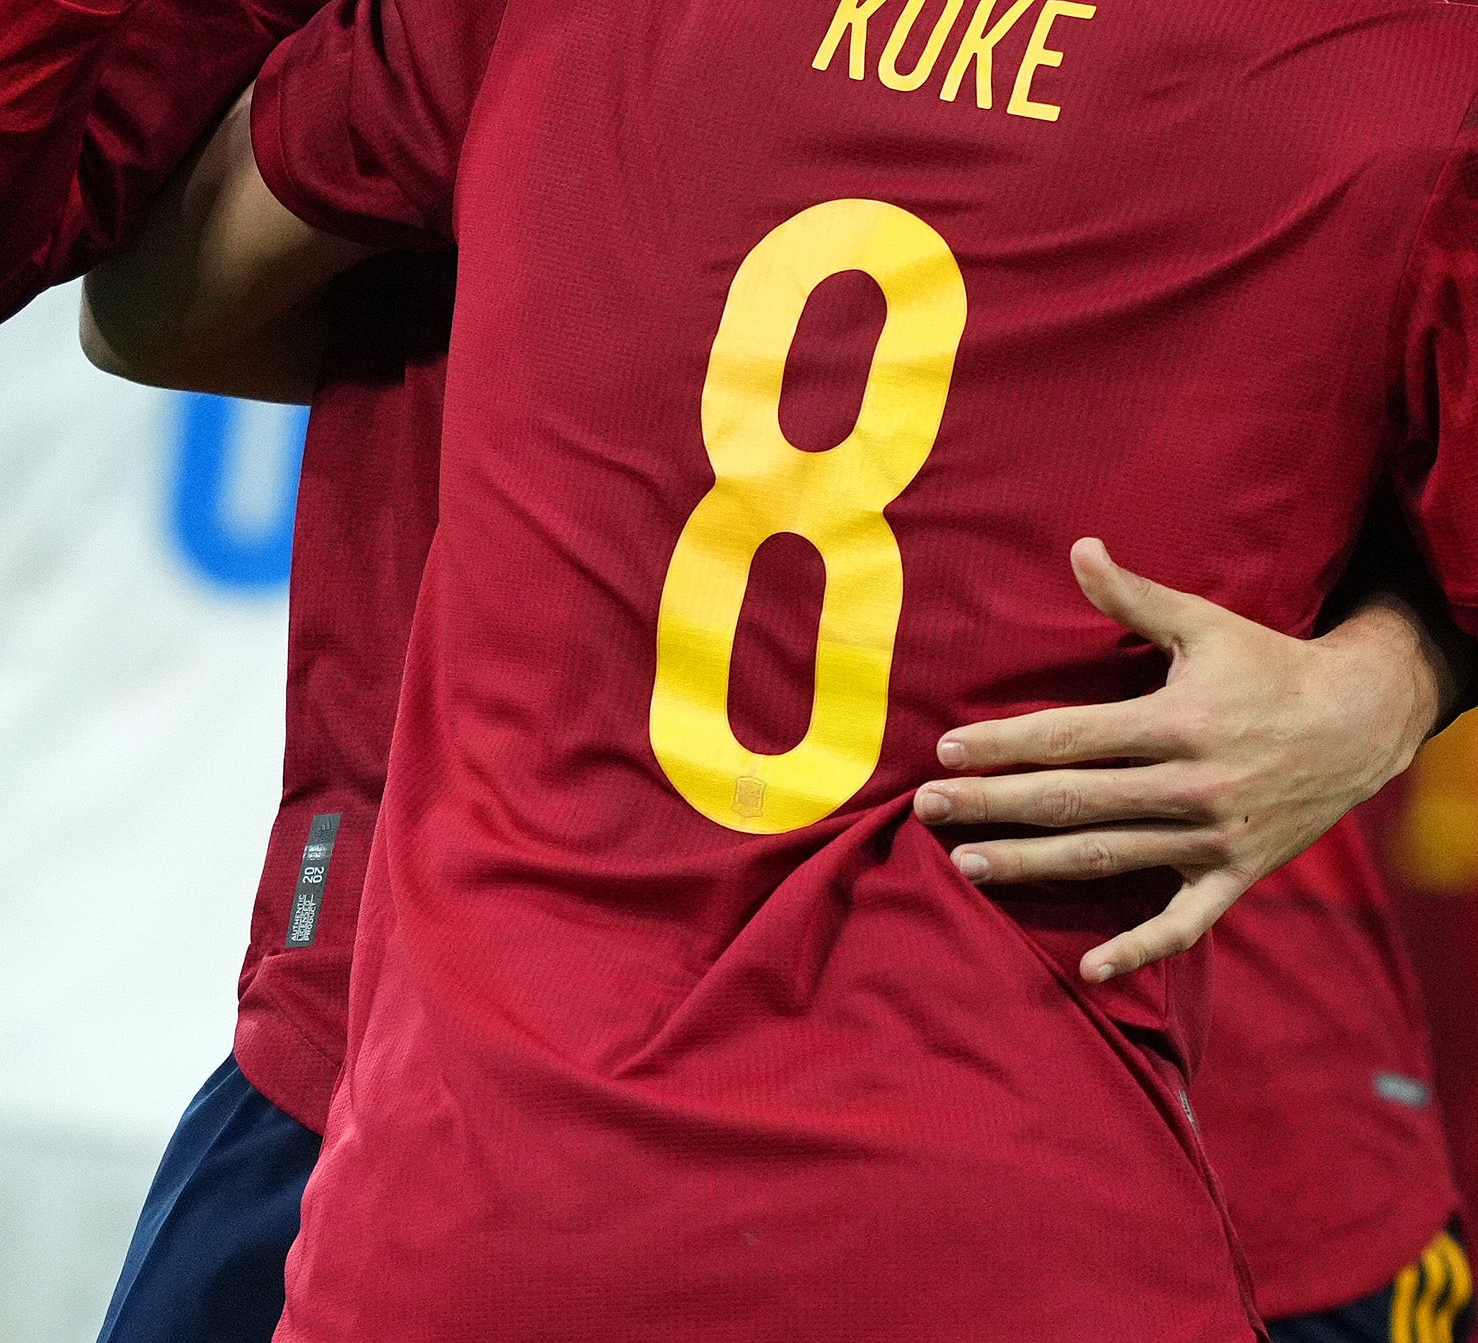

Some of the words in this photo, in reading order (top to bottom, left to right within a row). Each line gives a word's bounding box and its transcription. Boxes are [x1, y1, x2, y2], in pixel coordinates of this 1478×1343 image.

[649, 198, 968, 835] 8
[291, 894, 304, 941] AUTHENTIC
[304, 903, 317, 941] PRODUCT
